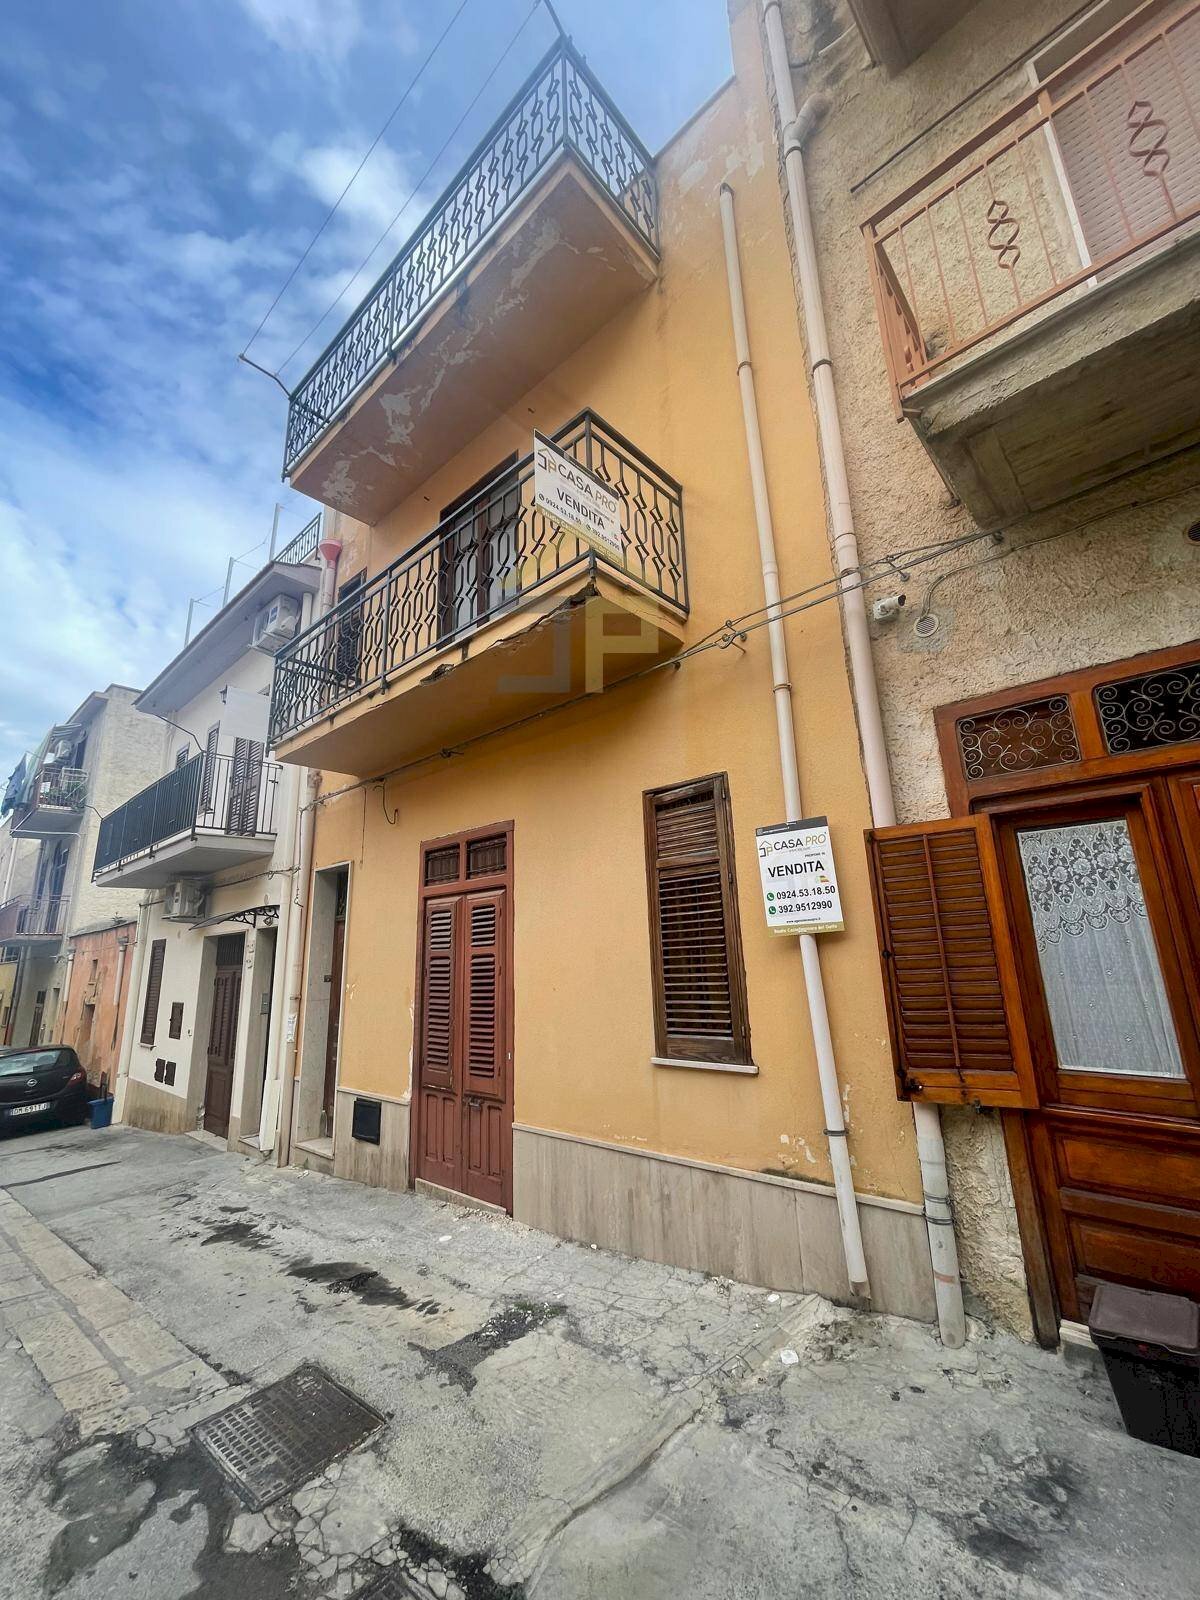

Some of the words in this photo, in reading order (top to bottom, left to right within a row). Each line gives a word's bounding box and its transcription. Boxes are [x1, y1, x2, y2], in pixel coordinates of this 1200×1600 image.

[558, 463, 594, 498] CASA
[595, 489, 617, 513] PRO
[557, 487, 605, 529] VENDITA
[773, 838, 804, 851] CASA
[805, 834, 826, 846] PRO
[767, 860, 825, 878] VENDITA
[776, 885, 836, 900] 0924.53.18.50
[778, 900, 833, 914] 392.9512990
